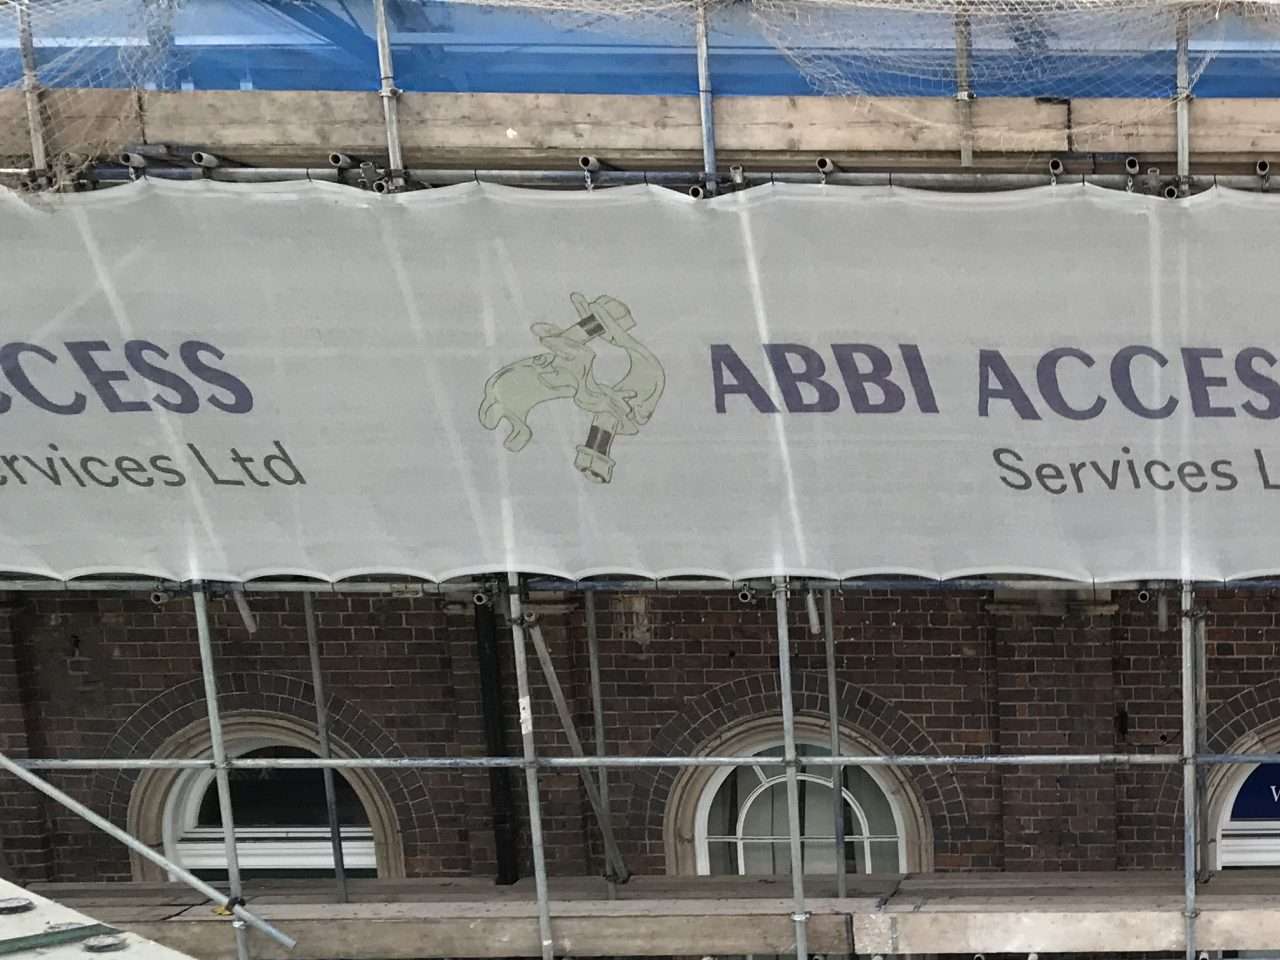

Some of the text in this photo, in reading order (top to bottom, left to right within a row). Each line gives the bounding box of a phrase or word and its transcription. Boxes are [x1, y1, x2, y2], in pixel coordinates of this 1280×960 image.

[0, 340, 254, 415] CESS
[709, 342, 940, 415] ABBI
[0, 442, 306, 487] rvices Ltd
[992, 447, 1238, 495] Services
